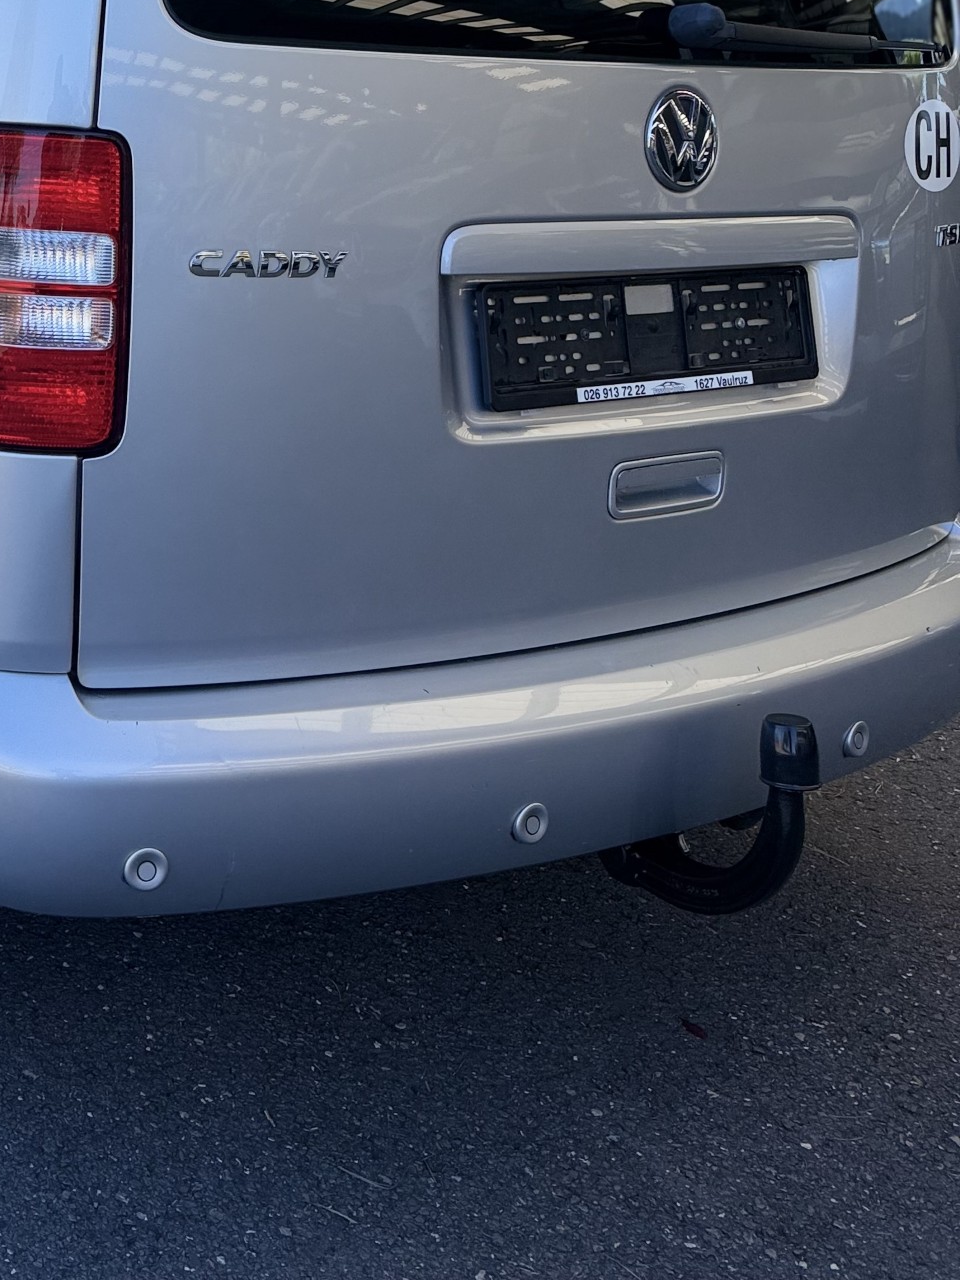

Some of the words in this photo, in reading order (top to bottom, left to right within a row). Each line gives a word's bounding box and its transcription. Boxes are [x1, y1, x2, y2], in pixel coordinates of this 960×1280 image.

[914, 109, 951, 181] CH
[188, 249, 349, 278] CADDY
[583, 388, 601, 401] 026
[603, 387, 620, 399] 913
[622, 385, 633, 397] 72
[635, 384, 646, 396] 22
[694, 377, 714, 390] 1627
[716, 374, 749, 387] Vaulruz
